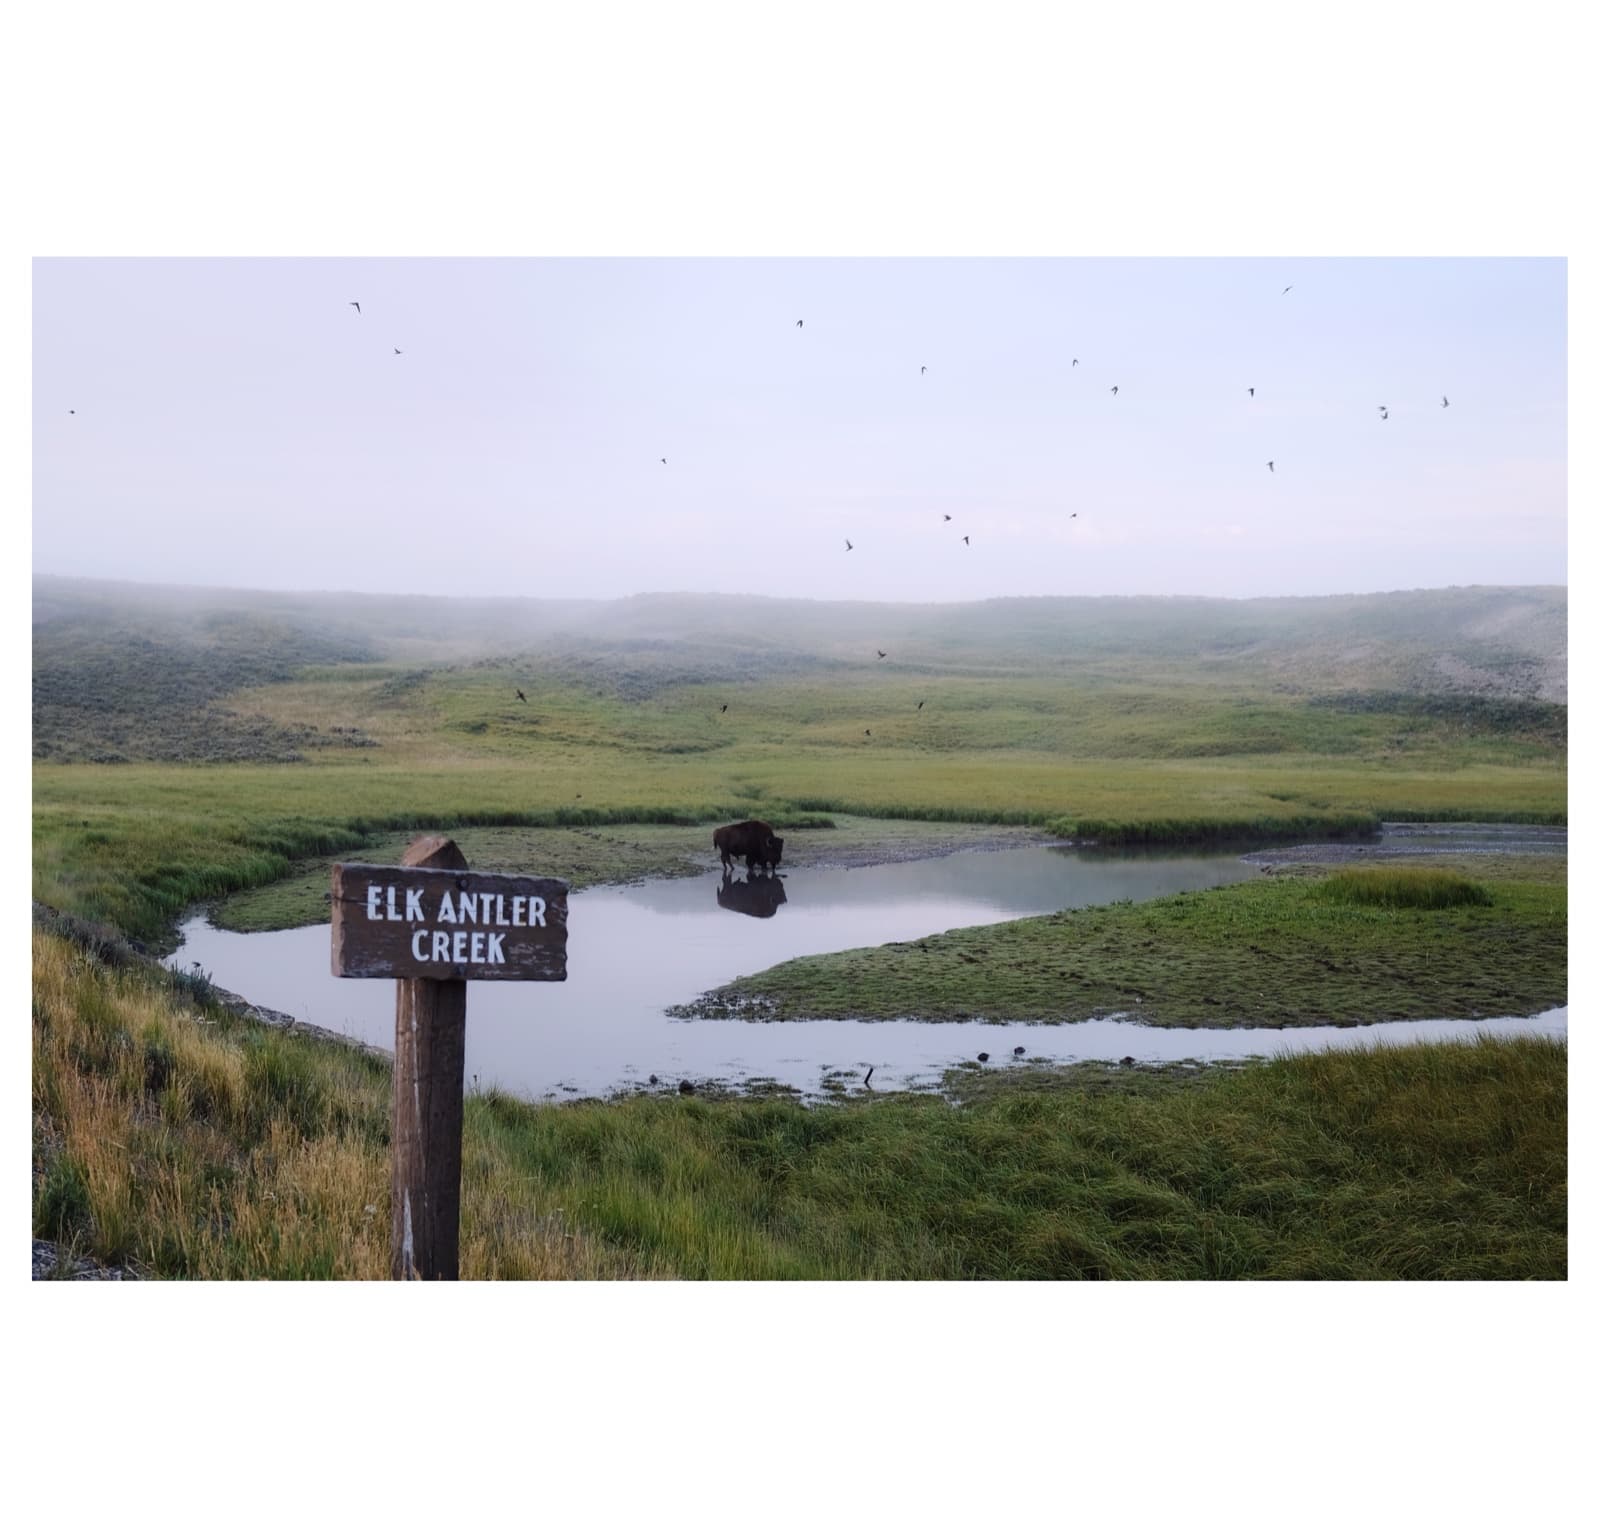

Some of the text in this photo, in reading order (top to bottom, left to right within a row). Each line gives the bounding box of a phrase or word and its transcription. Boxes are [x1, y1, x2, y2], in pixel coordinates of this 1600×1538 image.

[367, 886, 547, 927] ELK ANTLER
[411, 929, 506, 964] CREEK
